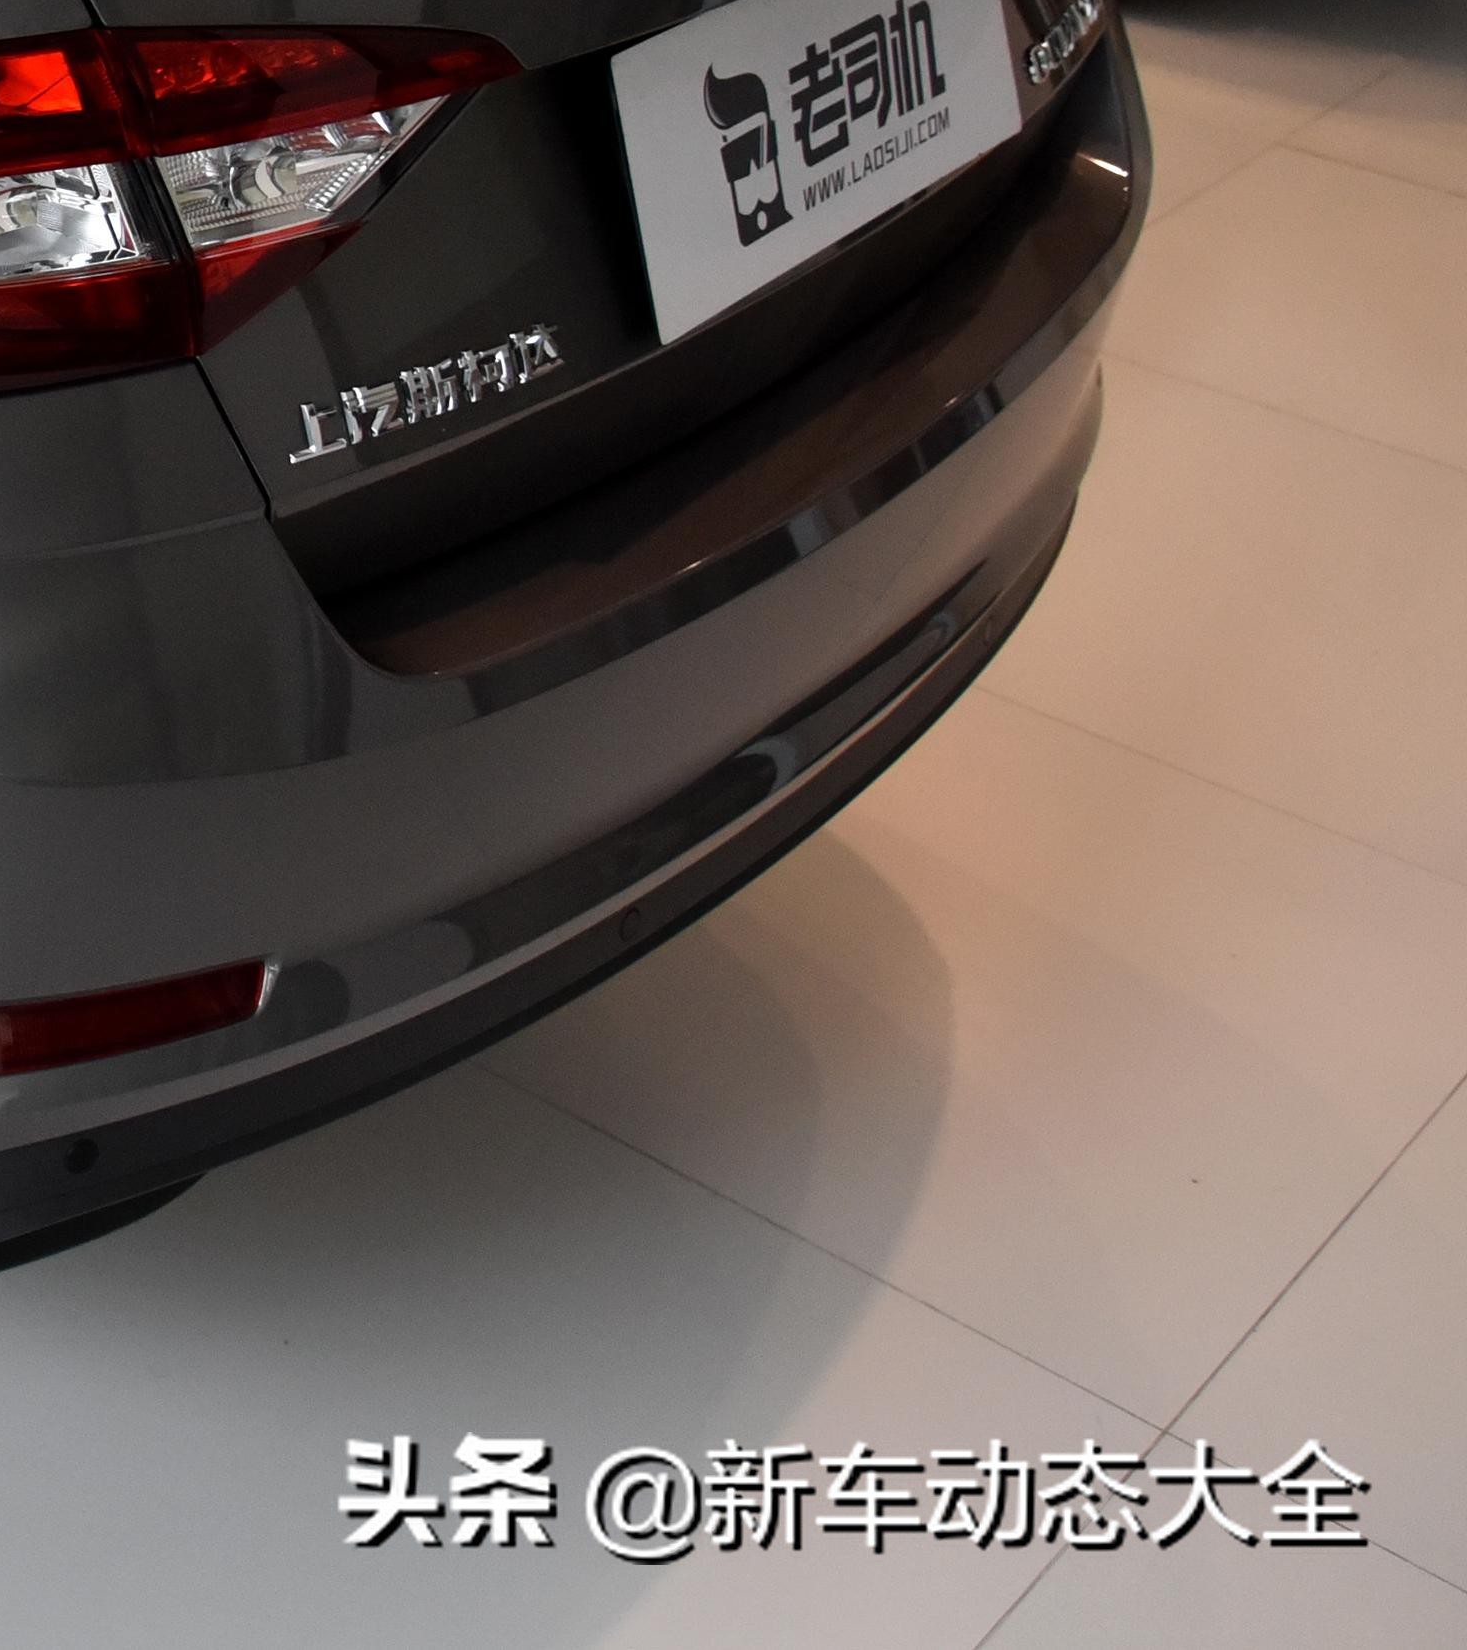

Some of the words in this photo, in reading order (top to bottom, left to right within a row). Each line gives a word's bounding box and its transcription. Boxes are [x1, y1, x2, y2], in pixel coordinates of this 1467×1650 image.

[803, 106, 951, 212] WWW.LAOSIJI.COM
[289, 323, 564, 464] 上汽斯柯达
